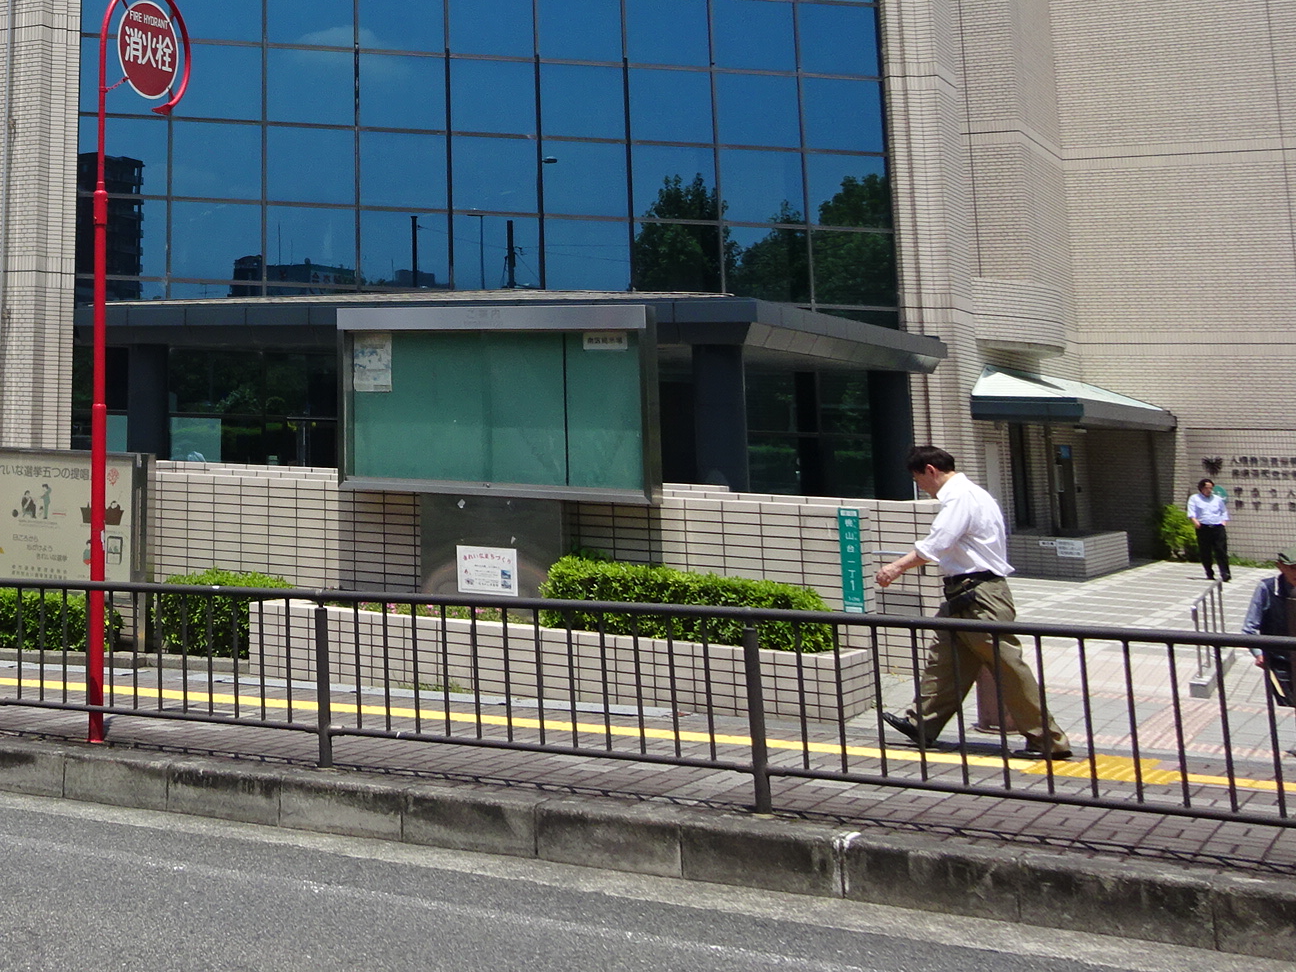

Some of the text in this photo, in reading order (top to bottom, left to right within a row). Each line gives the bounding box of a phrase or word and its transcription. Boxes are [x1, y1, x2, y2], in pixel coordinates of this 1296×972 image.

[129, 10, 168, 30] FIRE HYDRANT
[125, 26, 173, 72] 消火栓
